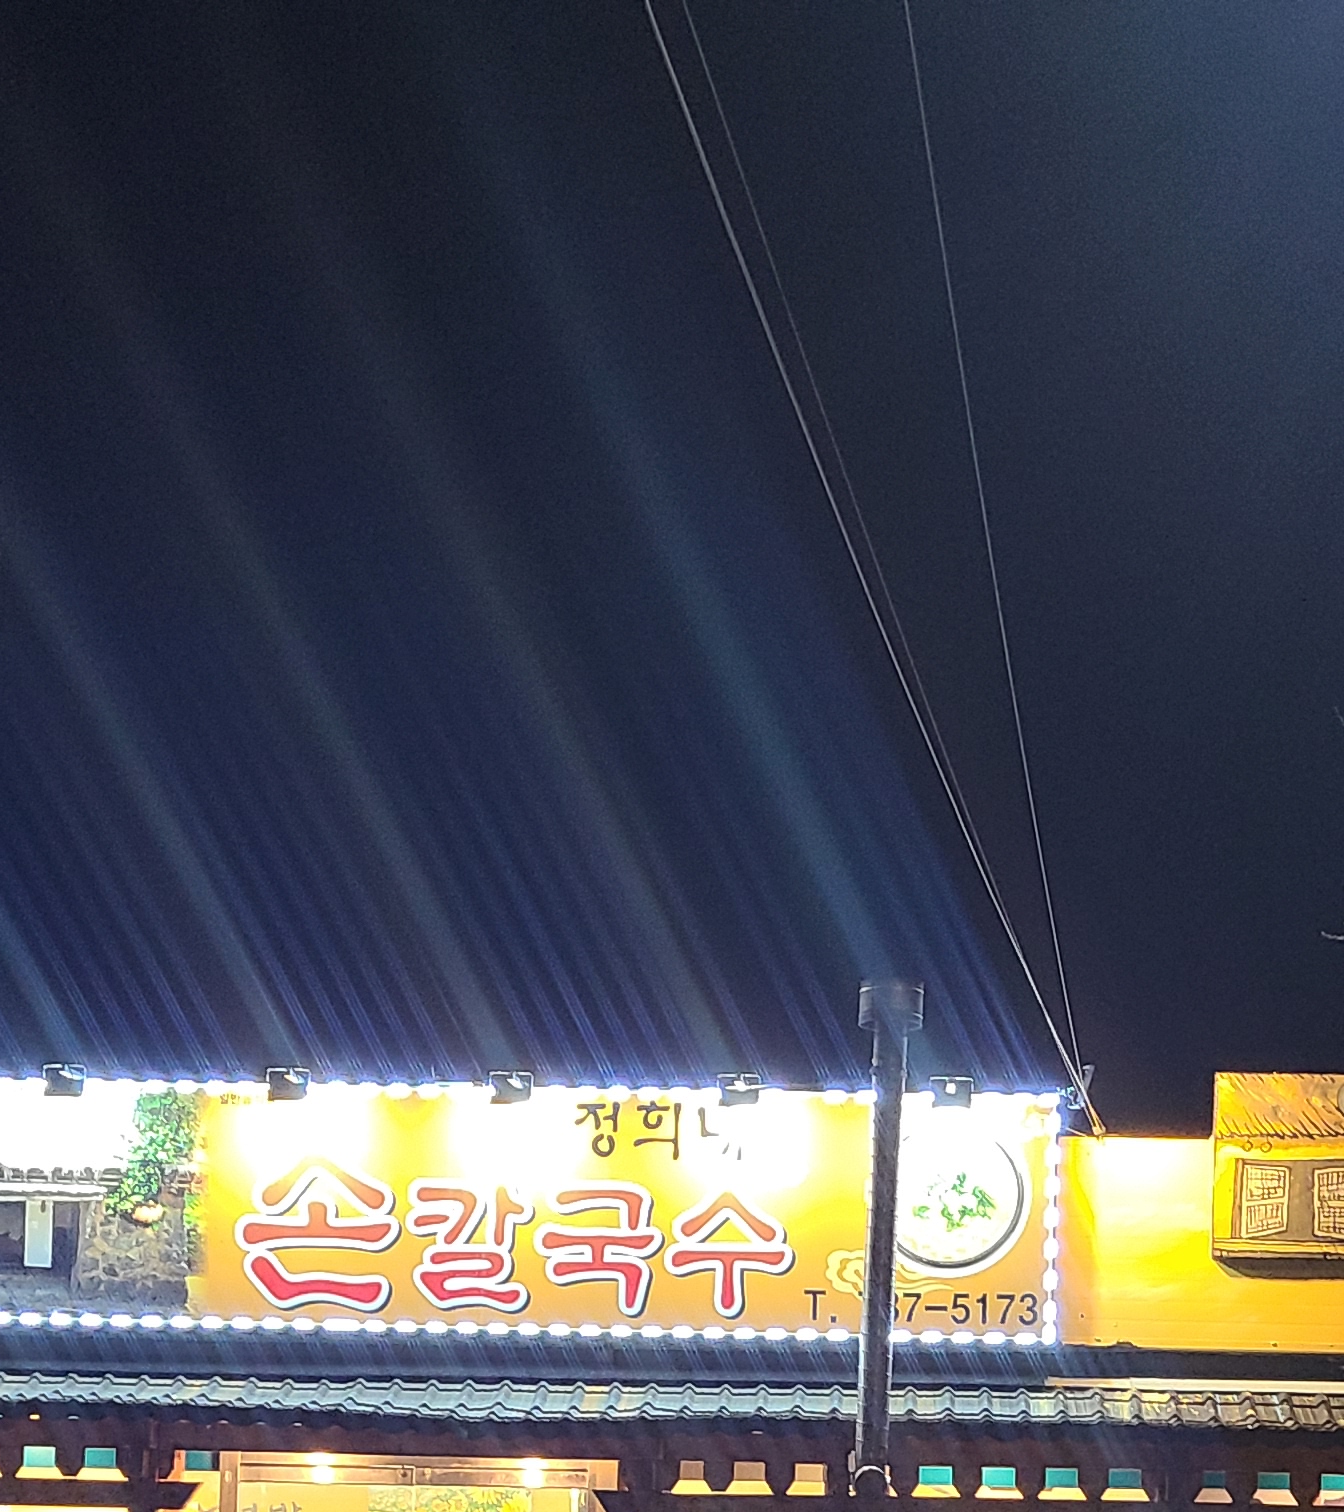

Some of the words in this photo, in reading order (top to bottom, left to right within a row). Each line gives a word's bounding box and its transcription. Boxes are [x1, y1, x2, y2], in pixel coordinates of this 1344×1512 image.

[574, 1099, 742, 1161] 정희
[804, 1291, 837, 1324] T.
[858, 1293, 1039, 1327] 7-5173
